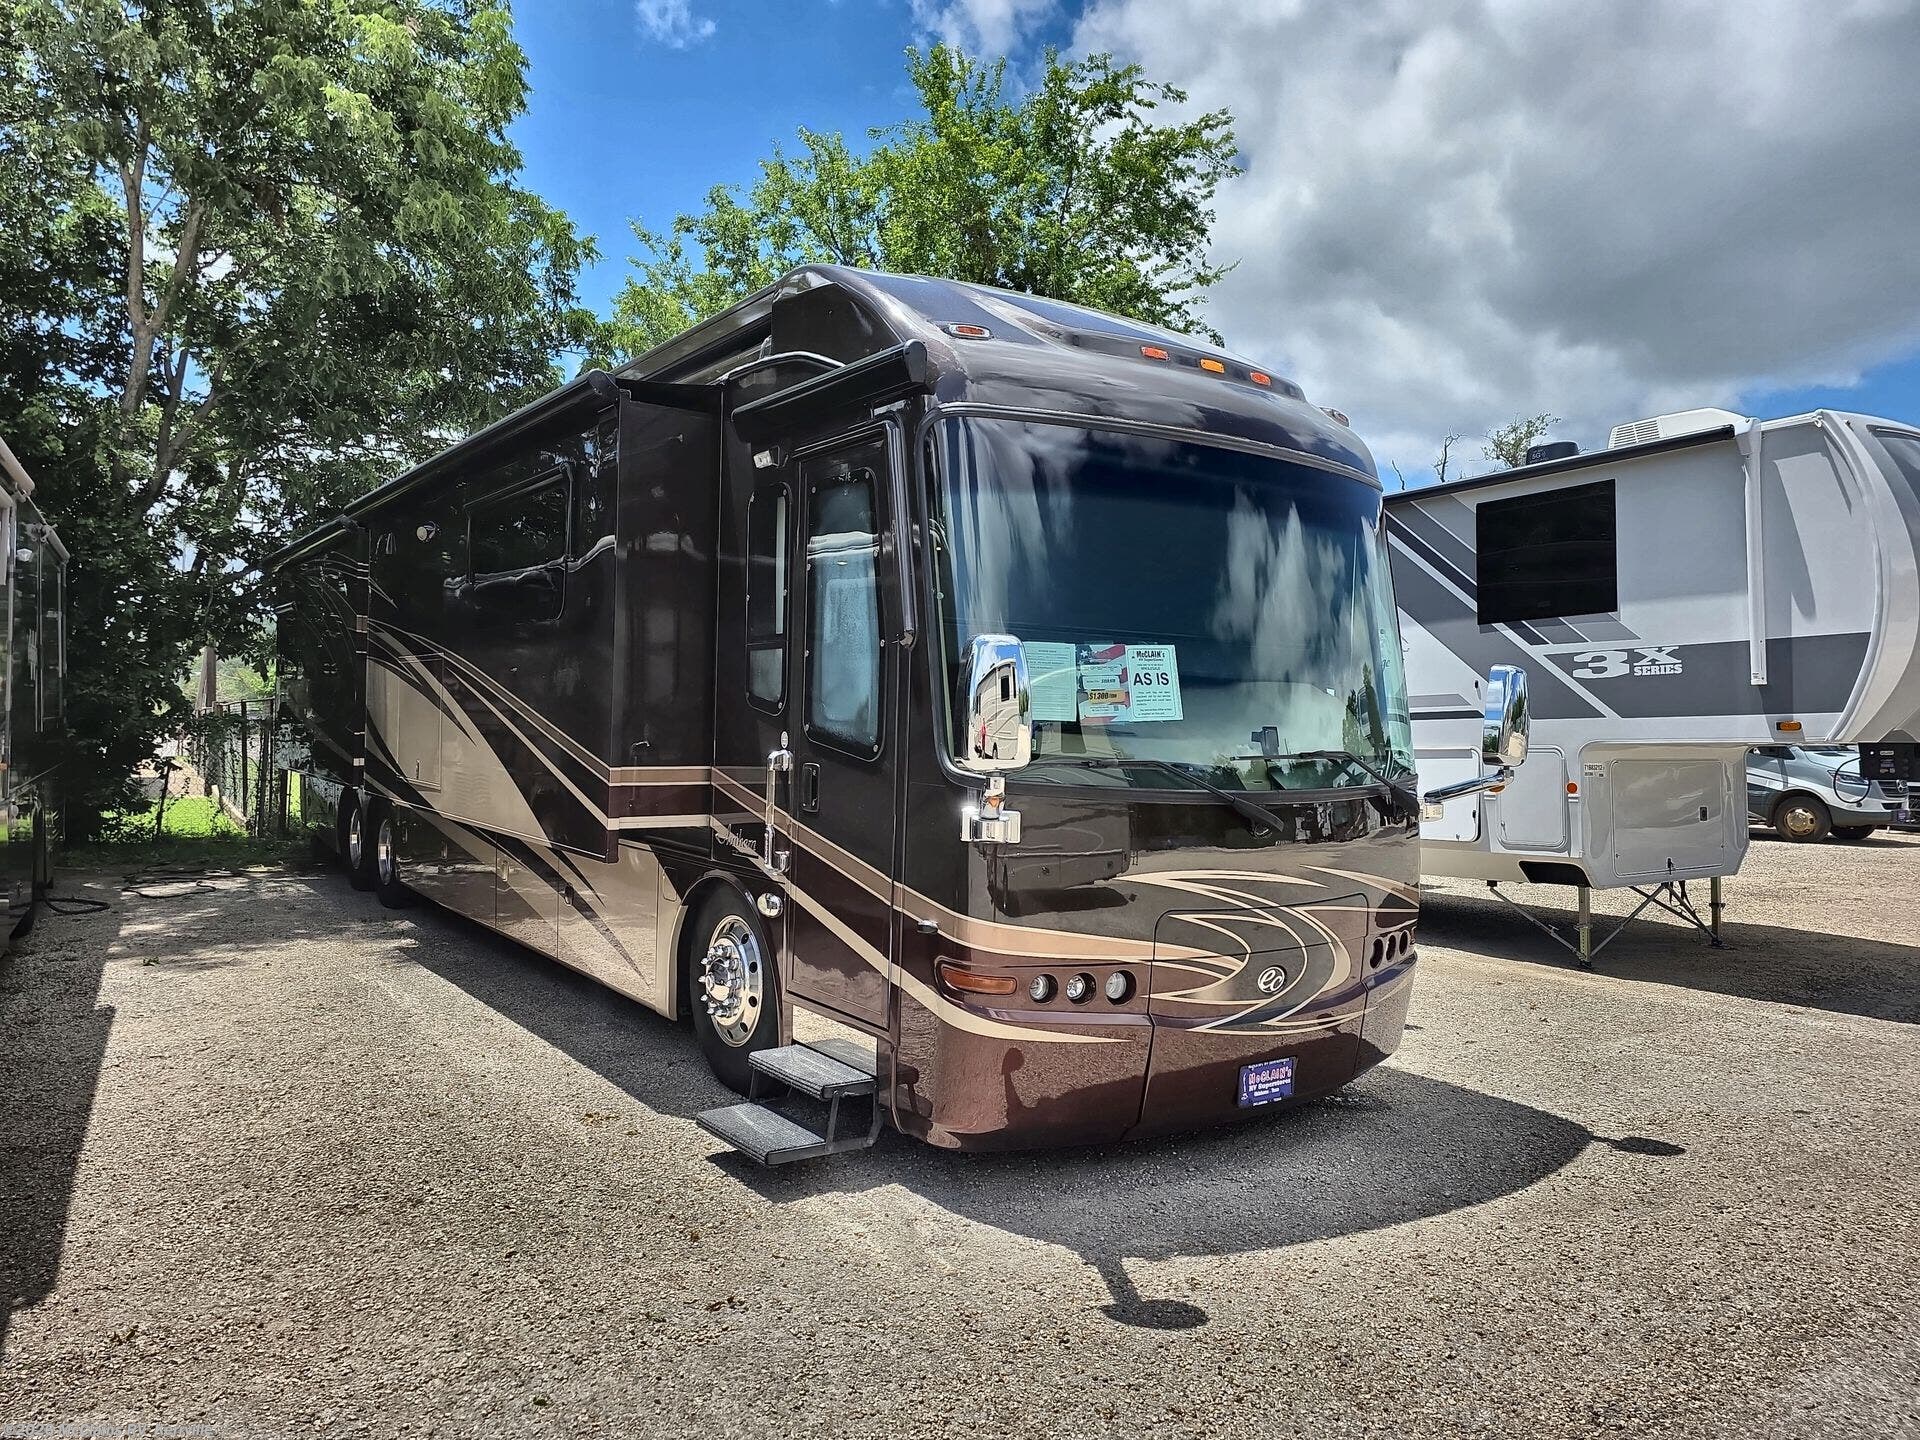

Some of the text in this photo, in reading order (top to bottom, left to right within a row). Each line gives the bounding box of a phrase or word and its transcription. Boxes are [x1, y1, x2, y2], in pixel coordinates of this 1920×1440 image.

[1634, 664, 1683, 676] SERIES
[1133, 672, 1169, 686] AS IS
